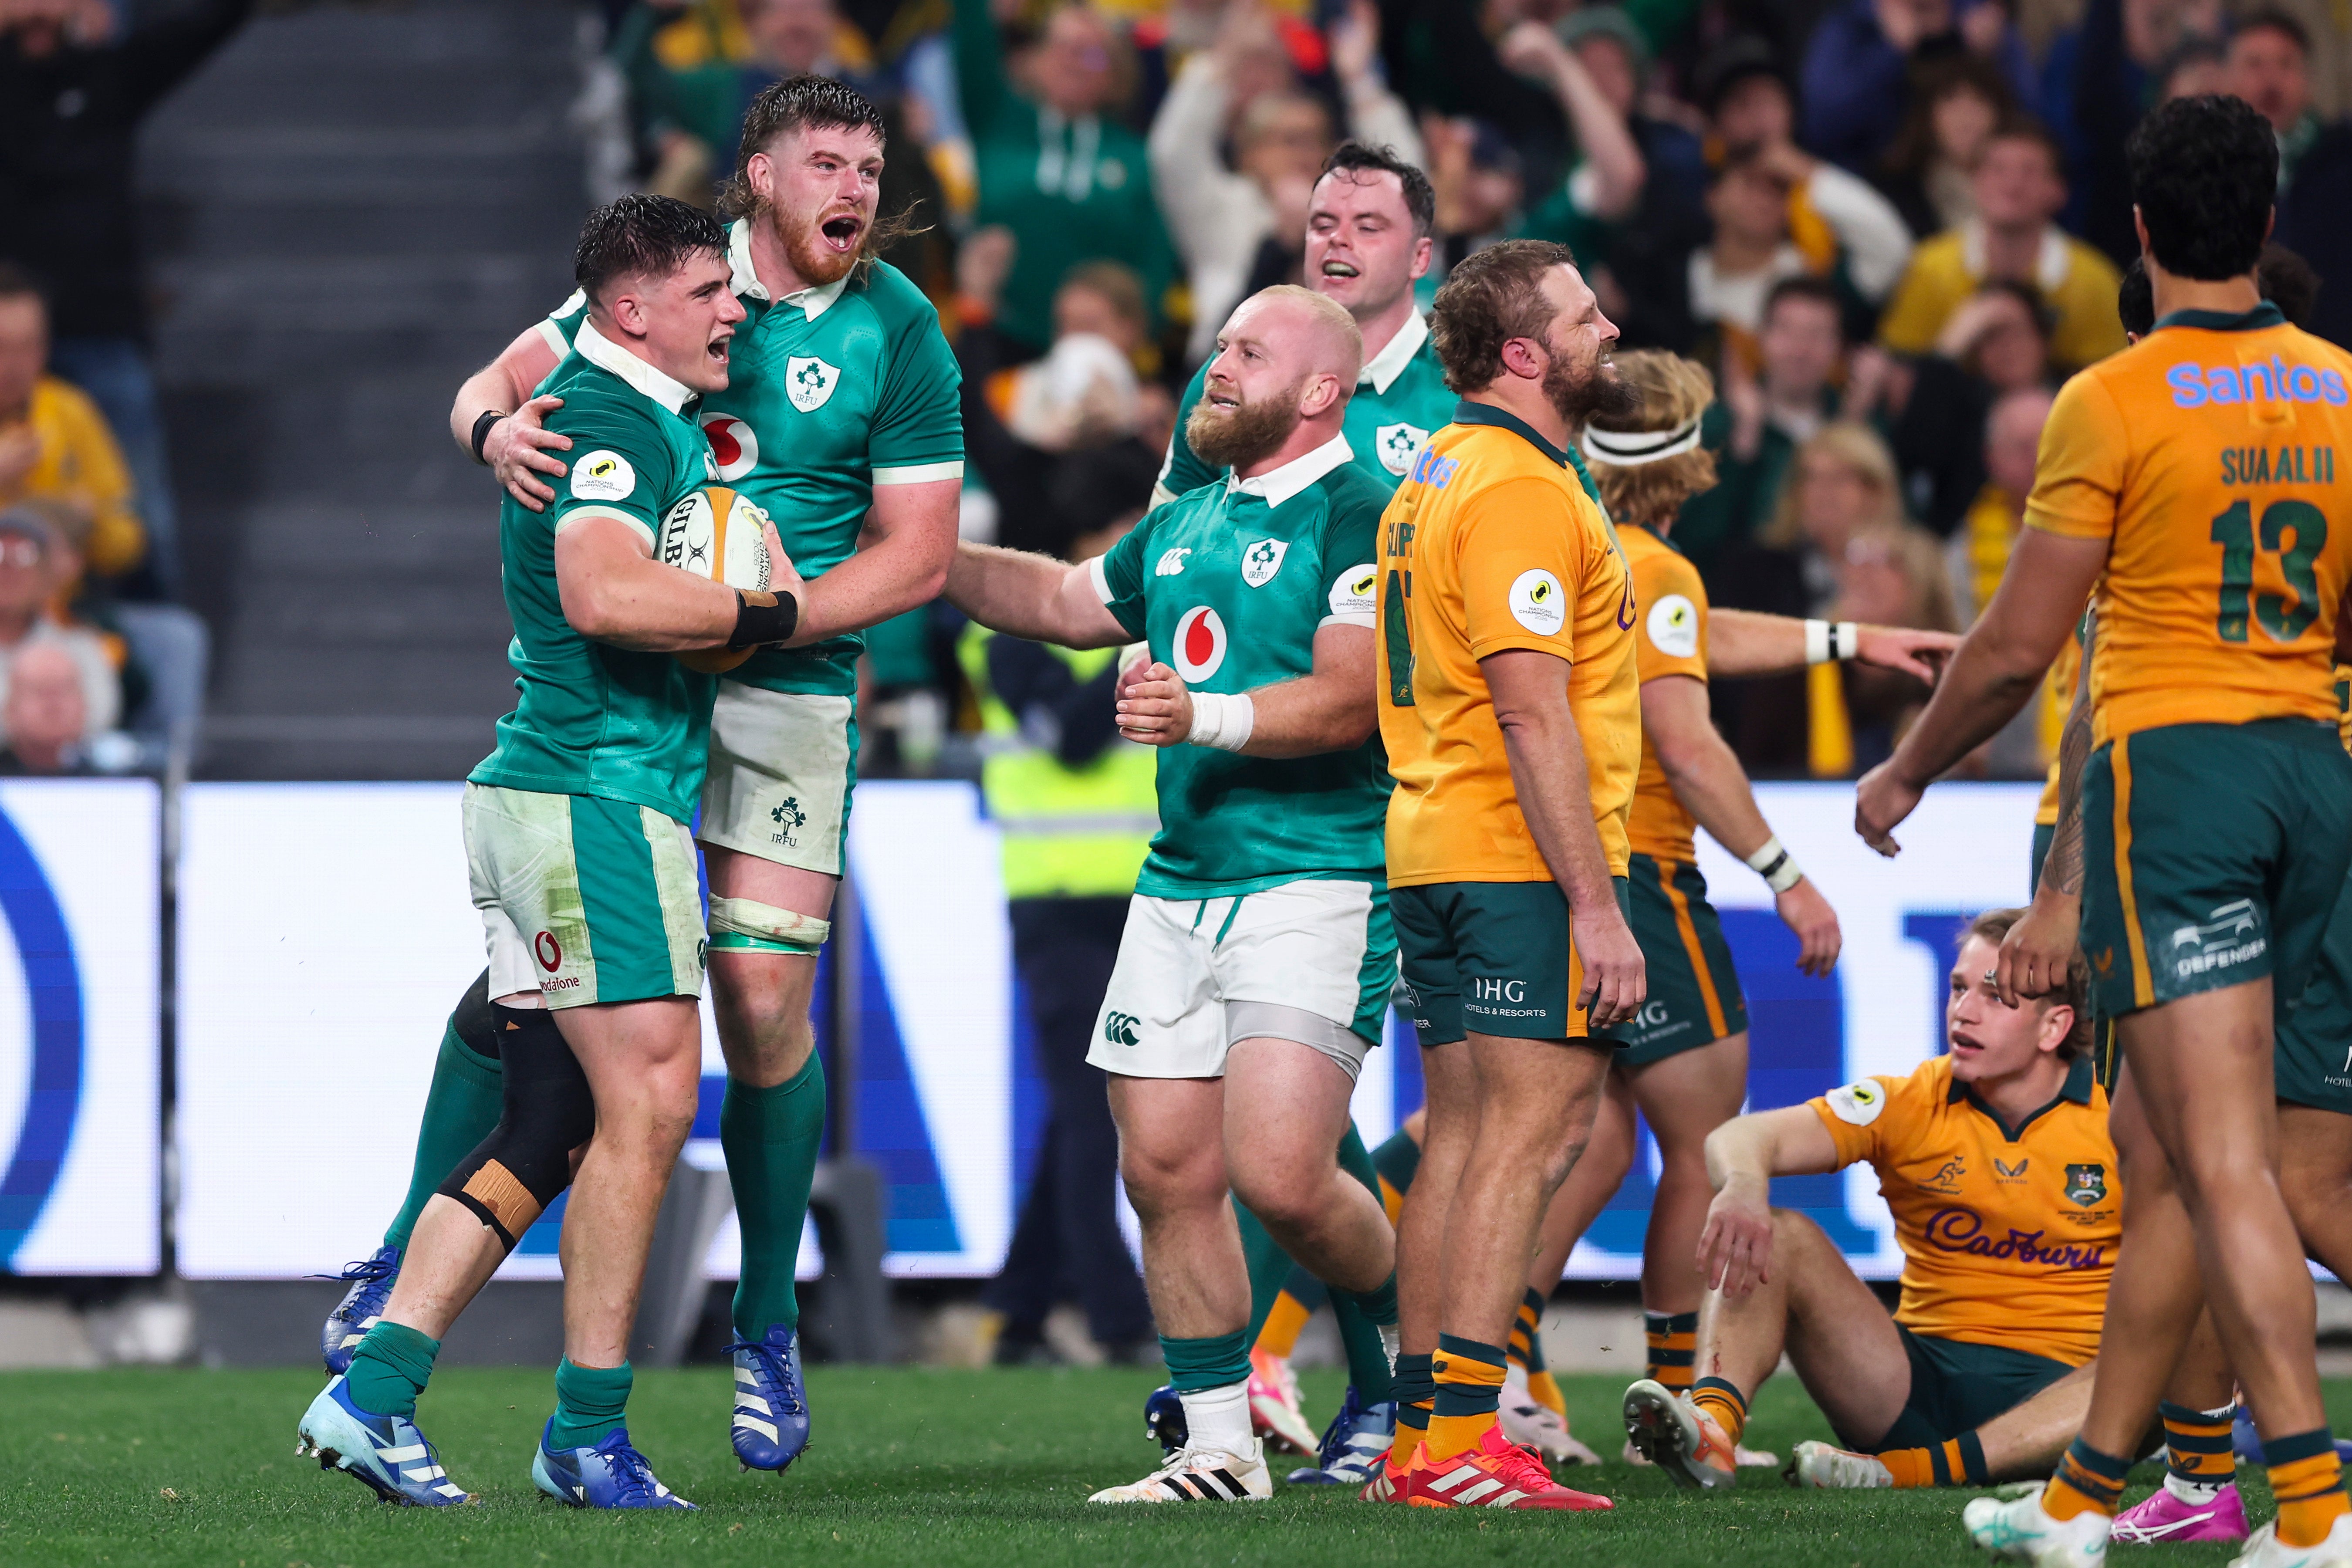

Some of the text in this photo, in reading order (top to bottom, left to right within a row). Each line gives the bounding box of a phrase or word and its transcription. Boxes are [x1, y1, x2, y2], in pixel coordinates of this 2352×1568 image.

[795, 393, 818, 405] IRFU
[2167, 354, 2349, 409] Santos
[2221, 446, 2334, 486] SUAALII
[576, 483, 623, 492] CHAMPIONSHIP
[665, 498, 697, 569] GILB
[756, 542, 764, 592] CHAMPIO
[761, 548, 770, 592] ATIONS
[2211, 498, 2327, 643] 13
[1518, 610, 1559, 620] CHAMPIONSHIP
[771, 833, 797, 847] IRFU
[1464, 1003, 1490, 1014] HOTELS
[1499, 1009, 1546, 1017] RESORTS
[1475, 978, 1524, 1002] IHG
[1925, 1207, 2105, 1268] Cadbury
